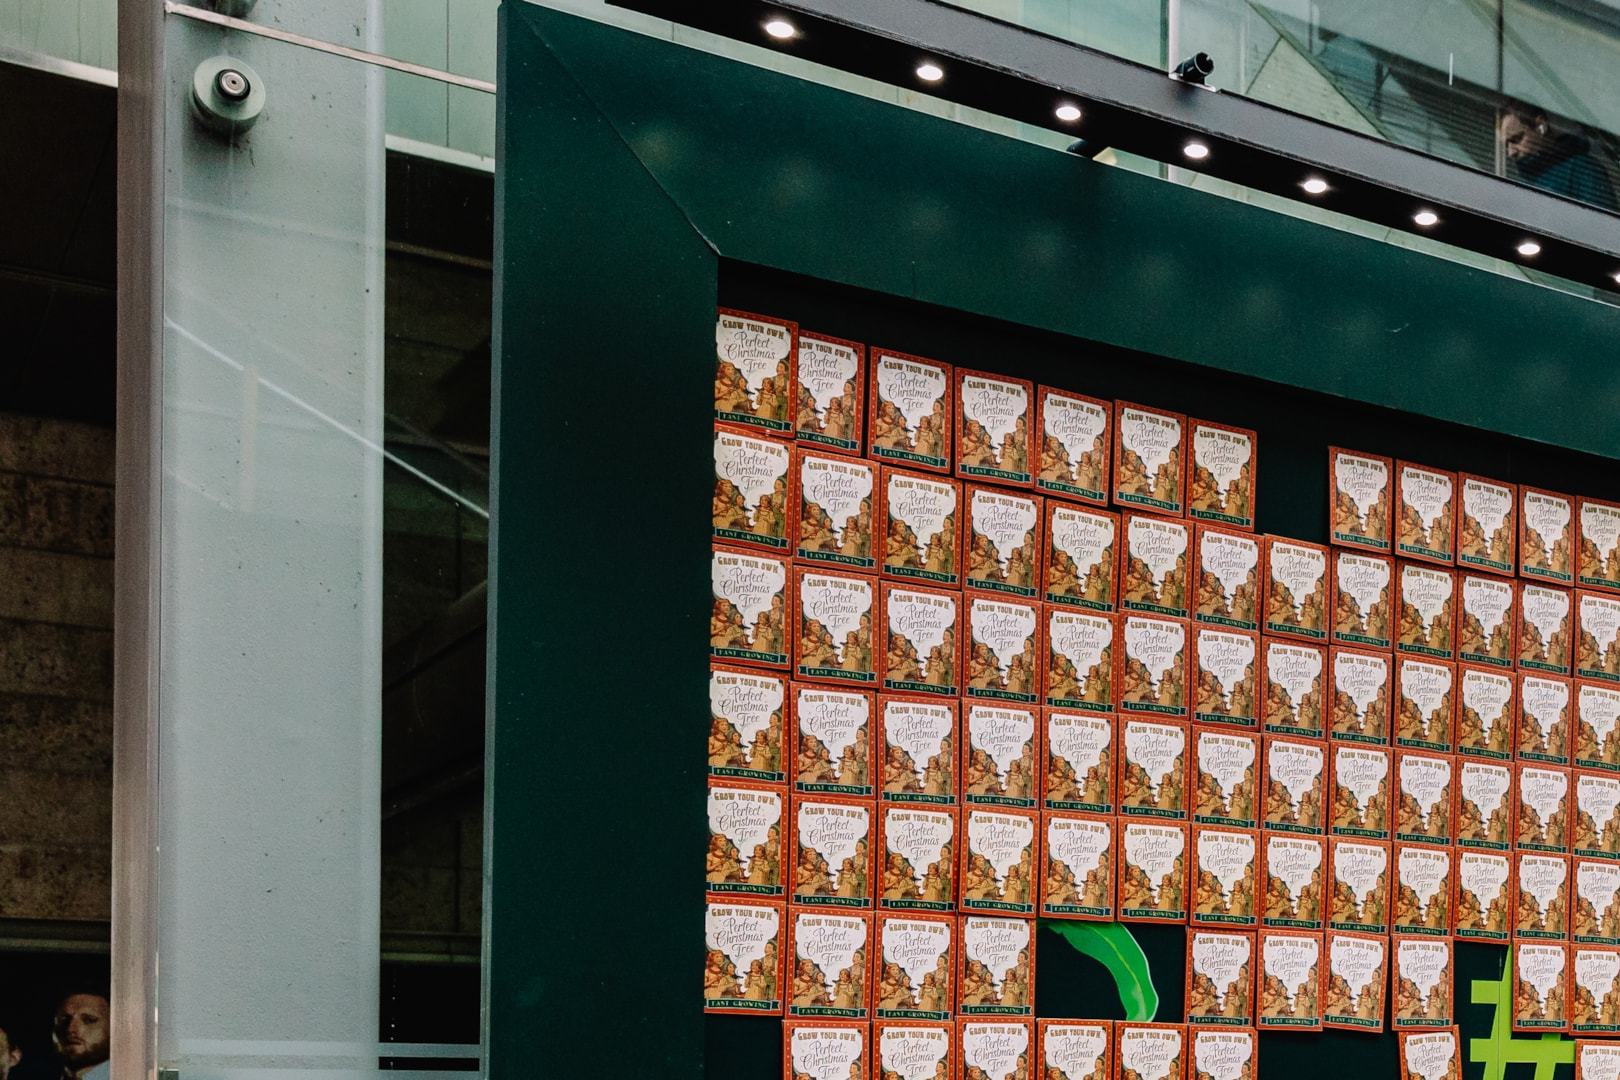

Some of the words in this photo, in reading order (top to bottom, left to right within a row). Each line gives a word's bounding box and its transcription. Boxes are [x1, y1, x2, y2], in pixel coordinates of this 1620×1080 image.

[884, 361, 903, 371] GROW
[905, 365, 921, 375] YOUR
[924, 369, 940, 381] OWN
[894, 372, 927, 388] Perfect
[885, 384, 932, 399] Christmas
[902, 399, 924, 411] Tree
[1049, 398, 1067, 408] GROW
[1069, 402, 1084, 412] YOUR
[1086, 407, 1101, 418] OWN
[1059, 409, 1088, 425] Perfect
[1050, 420, 1093, 435] Christmas
[1066, 434, 1085, 447] Tree
[1340, 458, 1354, 466] GROW
[1356, 460, 1368, 469] YOUR
[1370, 464, 1382, 473] OWN
[1348, 467, 1373, 481] Perfect
[1342, 477, 1377, 491] Christmas
[1355, 490, 1371, 501] Tree
[807, 579, 827, 587] GROW
[830, 580, 846, 589] YOUR
[849, 583, 866, 594] OWN
[819, 588, 852, 605] Perfect
[810, 601, 858, 617] Christmas
[828, 615, 850, 628] Tree
[1304, 844, 1317, 852] OWN
[1281, 849, 1307, 863] Perfect
[1273, 860, 1311, 875] Christmas
[1287, 872, 1304, 883] Tree
[1550, 949, 1561, 957] OWN
[1530, 955, 1552, 968] Perfect
[1524, 965, 1556, 979] Christmas
[1535, 976, 1550, 986] Tree
[797, 1032, 818, 1040] GROW
[839, 1033, 856, 1041] OWN
[1162, 1033, 1176, 1041] OWN
[809, 1040, 843, 1057] Perfect
[1136, 1040, 1164, 1055] Perfect
[800, 1053, 848, 1070] Christmas
[1128, 1051, 1169, 1067] Christmas
[818, 1066, 840, 1079] Tree
[1143, 1063, 1161, 1075] Tree
